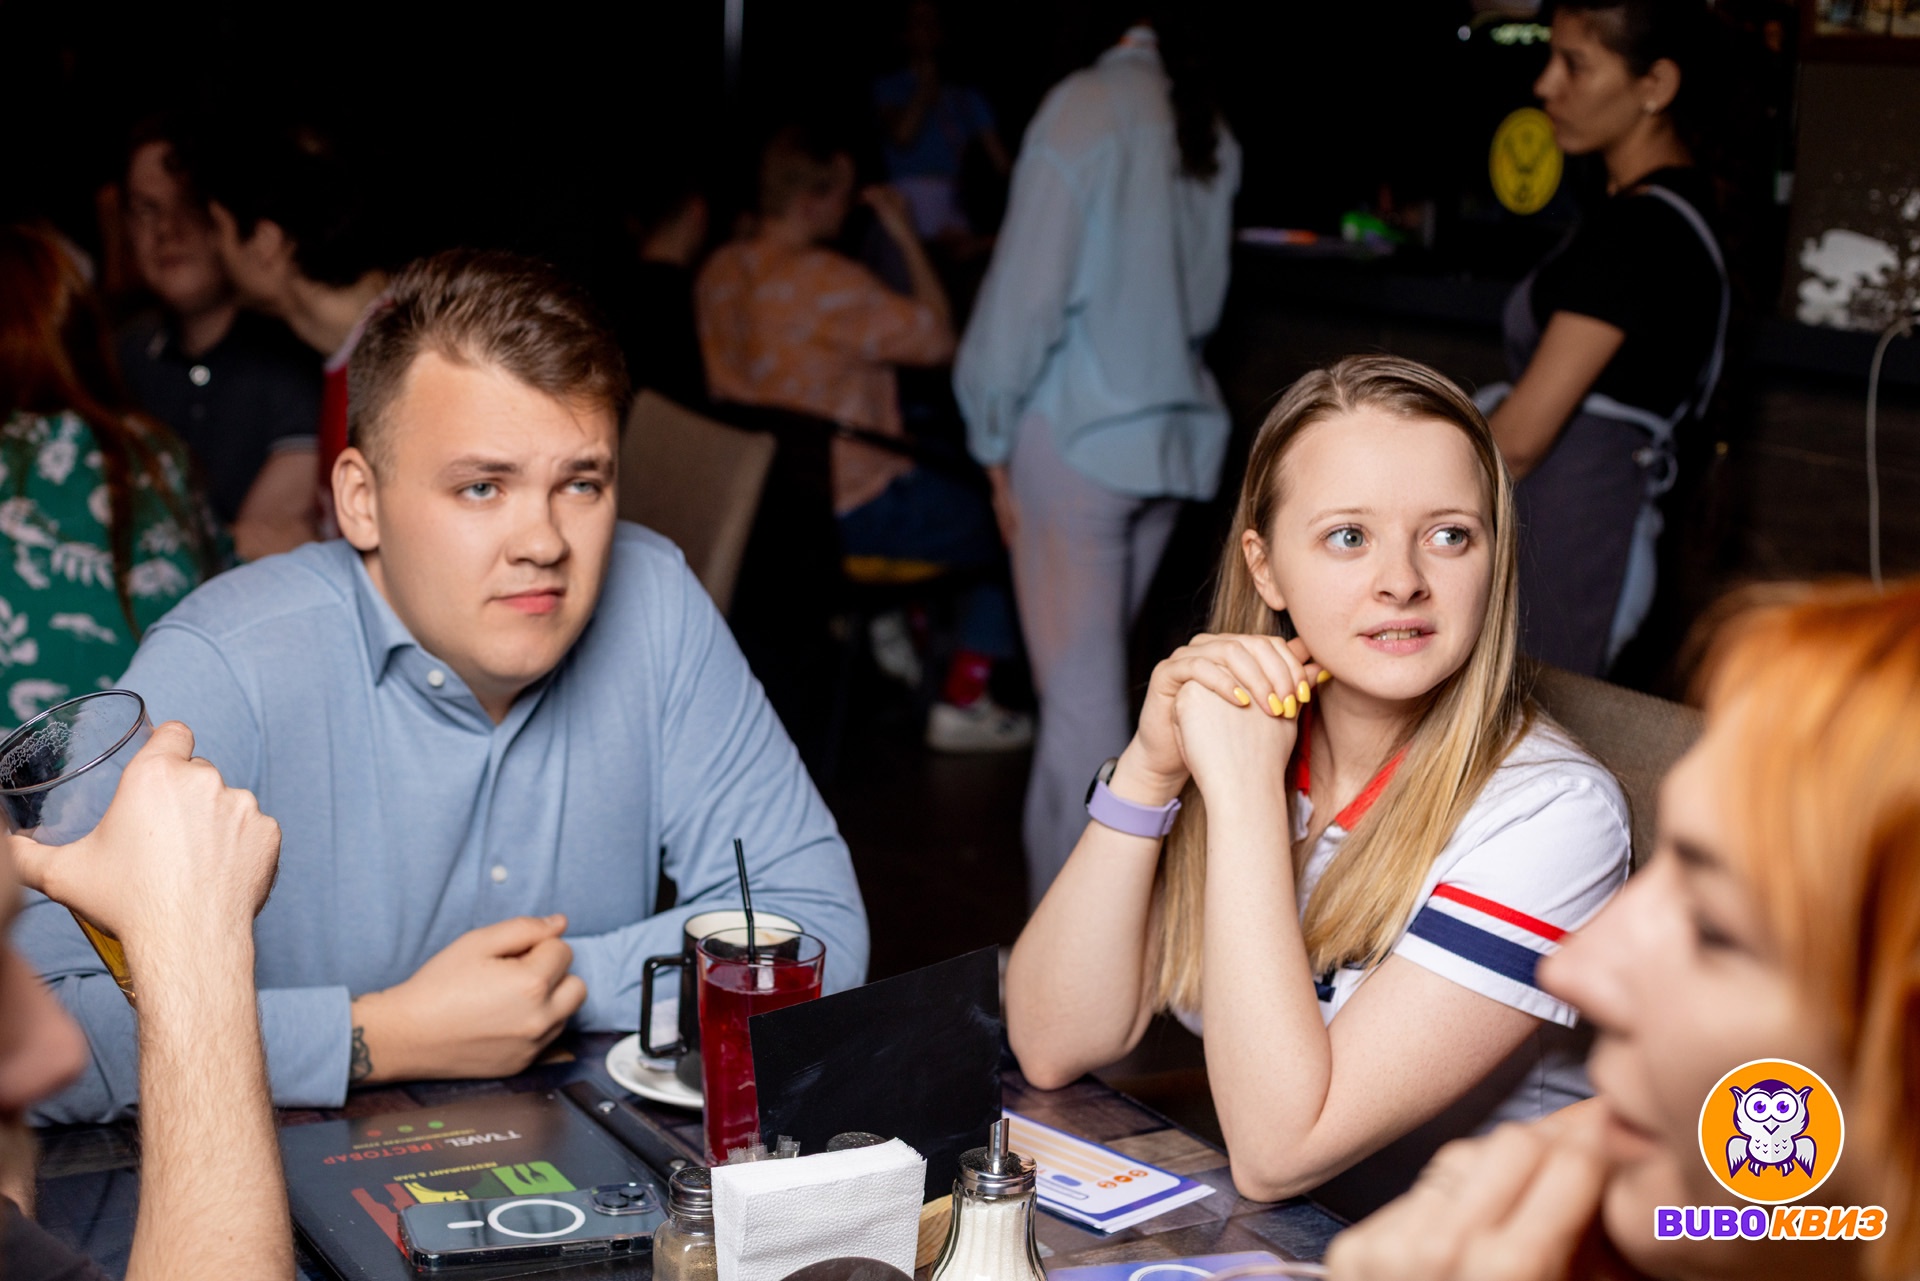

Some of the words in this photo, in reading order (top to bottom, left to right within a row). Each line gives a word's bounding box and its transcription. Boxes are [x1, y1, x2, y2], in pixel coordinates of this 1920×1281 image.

[444, 1130, 522, 1147] TRAVEL
[323, 1143, 434, 1165] РЕСТОБАР
[393, 1173, 417, 1181] BAR
[429, 1161, 498, 1177] RESTAURANT
